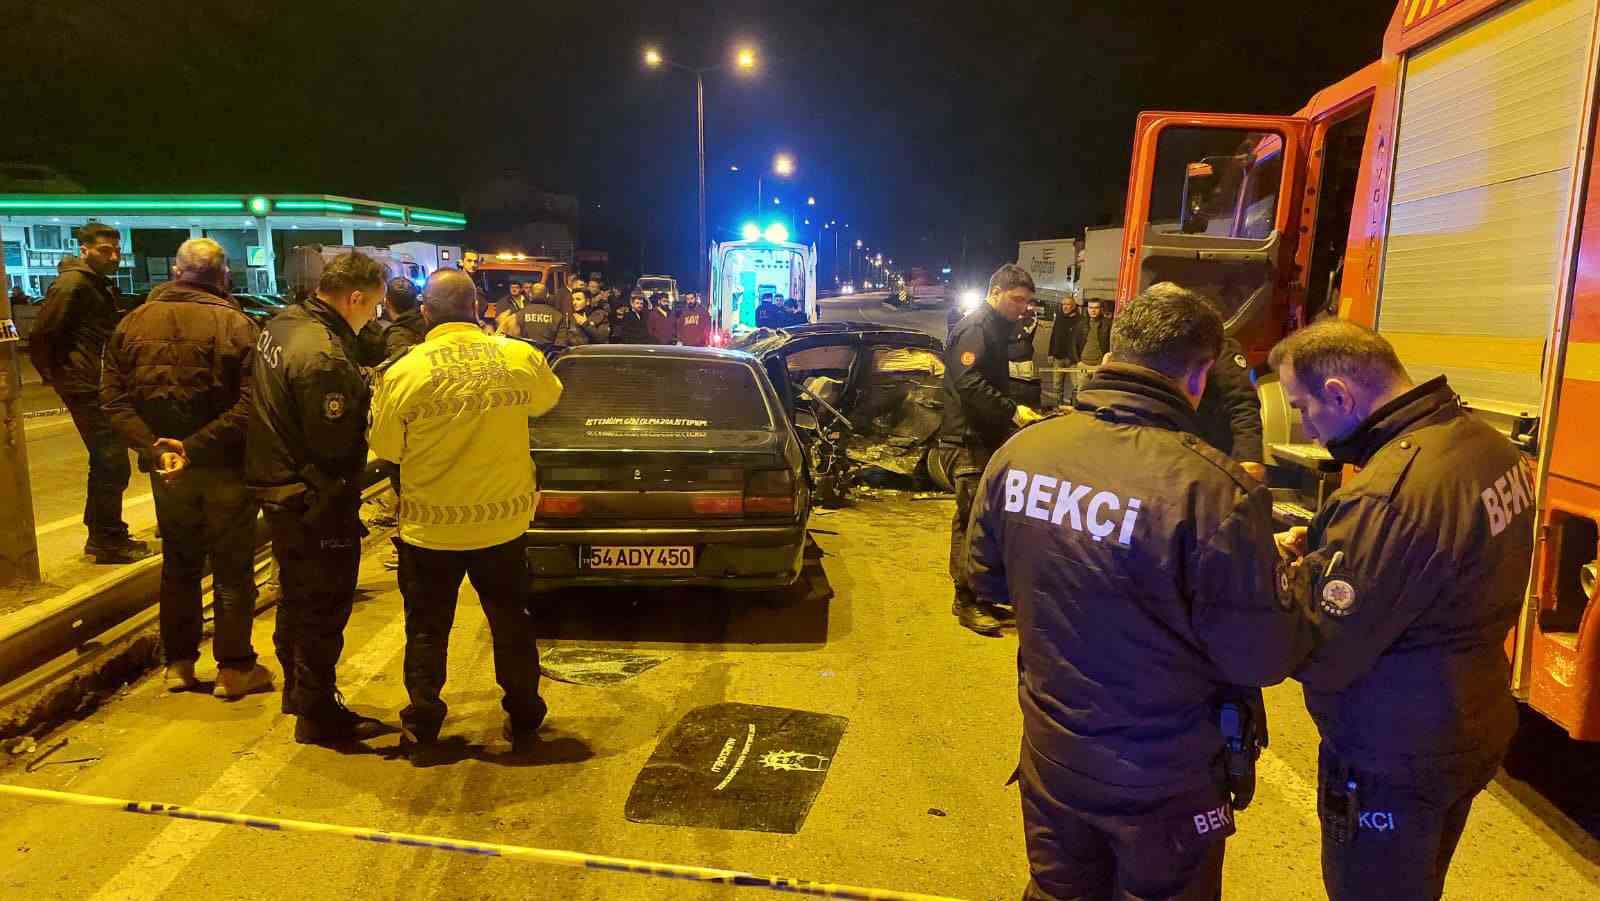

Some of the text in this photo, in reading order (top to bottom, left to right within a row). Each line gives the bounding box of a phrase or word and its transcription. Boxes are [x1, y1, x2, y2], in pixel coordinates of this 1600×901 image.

[591, 548, 691, 567] 54 ADY 450
